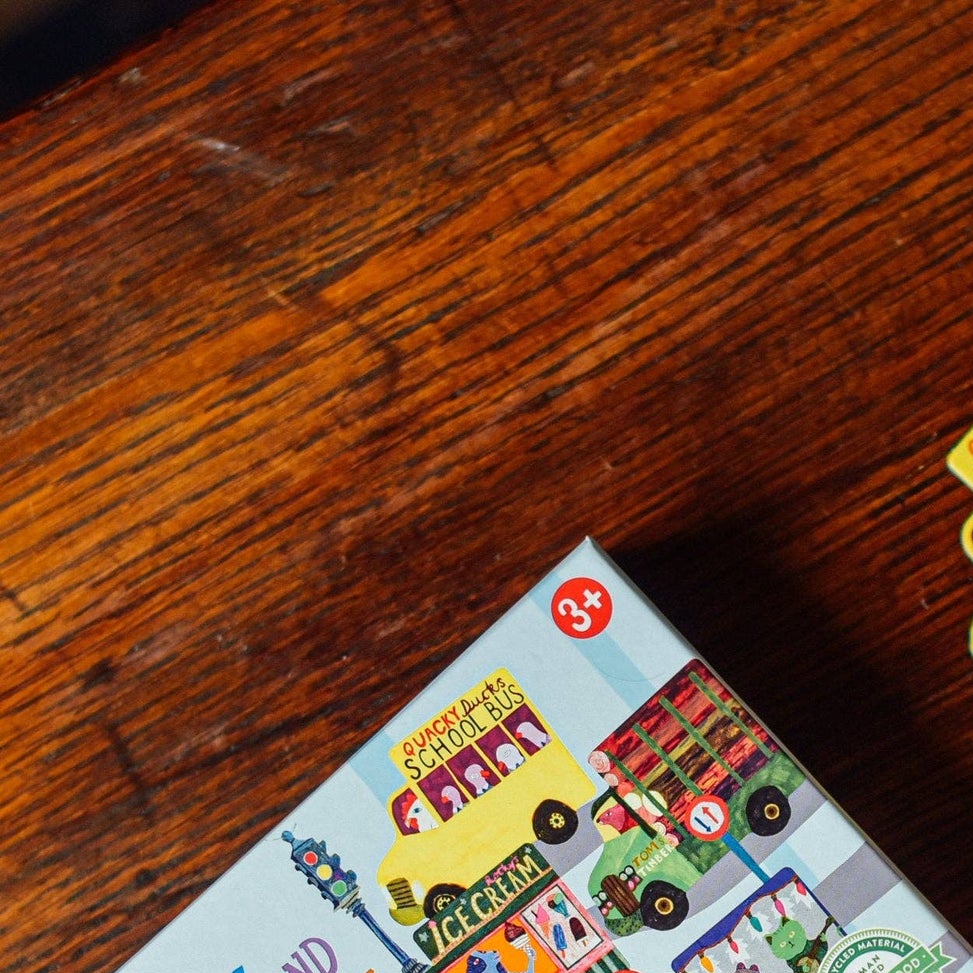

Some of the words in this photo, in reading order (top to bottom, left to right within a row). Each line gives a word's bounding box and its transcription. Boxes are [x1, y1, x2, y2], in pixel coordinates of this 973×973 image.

[558, 588, 602, 632] 3+
[403, 706, 460, 756] QUACKY
[460, 678, 506, 718] Ducks
[404, 714, 487, 780] SCHOOL
[484, 684, 524, 721] BUS
[637, 844, 675, 877] TIMBER
[428, 906, 475, 955] ICE
[471, 854, 545, 920] CREAM
[858, 939, 905, 953] MATERIAL
